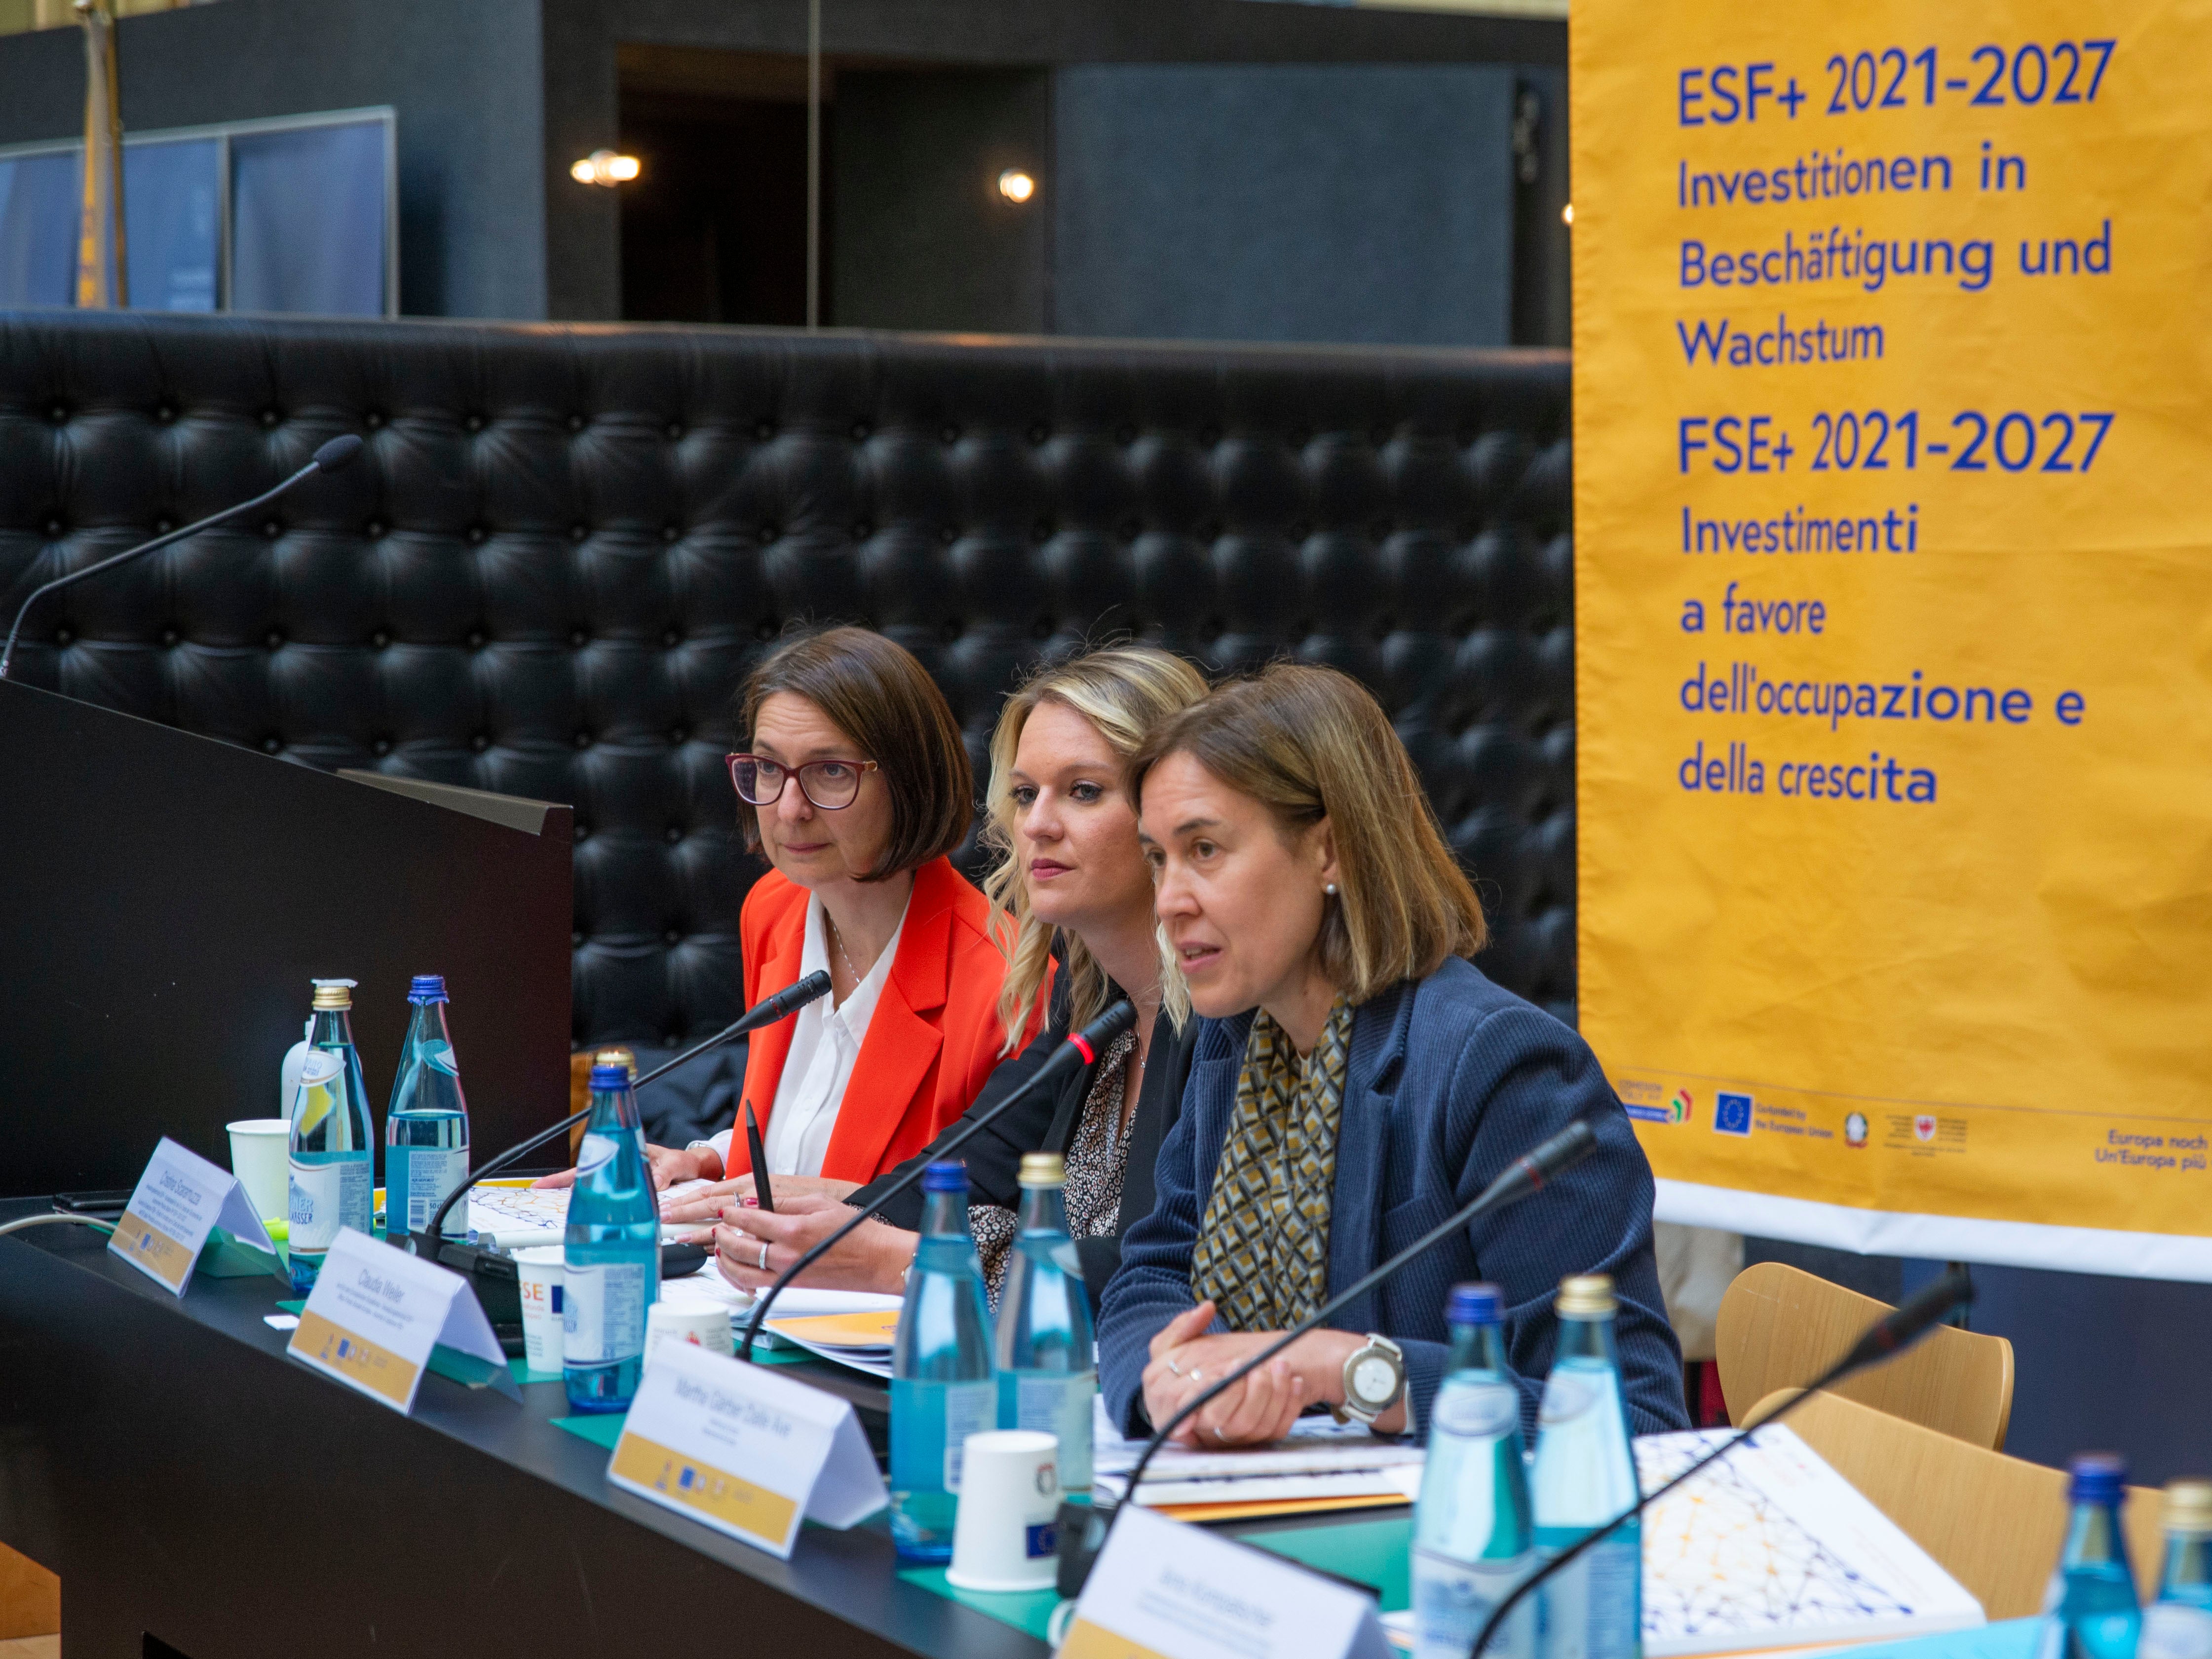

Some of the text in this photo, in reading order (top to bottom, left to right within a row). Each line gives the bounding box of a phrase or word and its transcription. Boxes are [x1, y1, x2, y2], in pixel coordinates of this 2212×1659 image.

[1679, 39, 2116, 126] ESF+ 2021-2027
[1679, 141, 2025, 207] Investitionen in
[1680, 220, 2110, 292] Beschäftigung und
[1677, 314, 1883, 366] Wachstum
[1679, 410, 2114, 474] FSE+ 2021-2027
[1683, 503, 1918, 553] Investimenti
[1681, 582, 1825, 634] a favore
[1680, 662, 2085, 730] dell'occupazione e
[1679, 741, 1936, 803] della crescita
[2107, 1129, 2209, 1150] Europa noch
